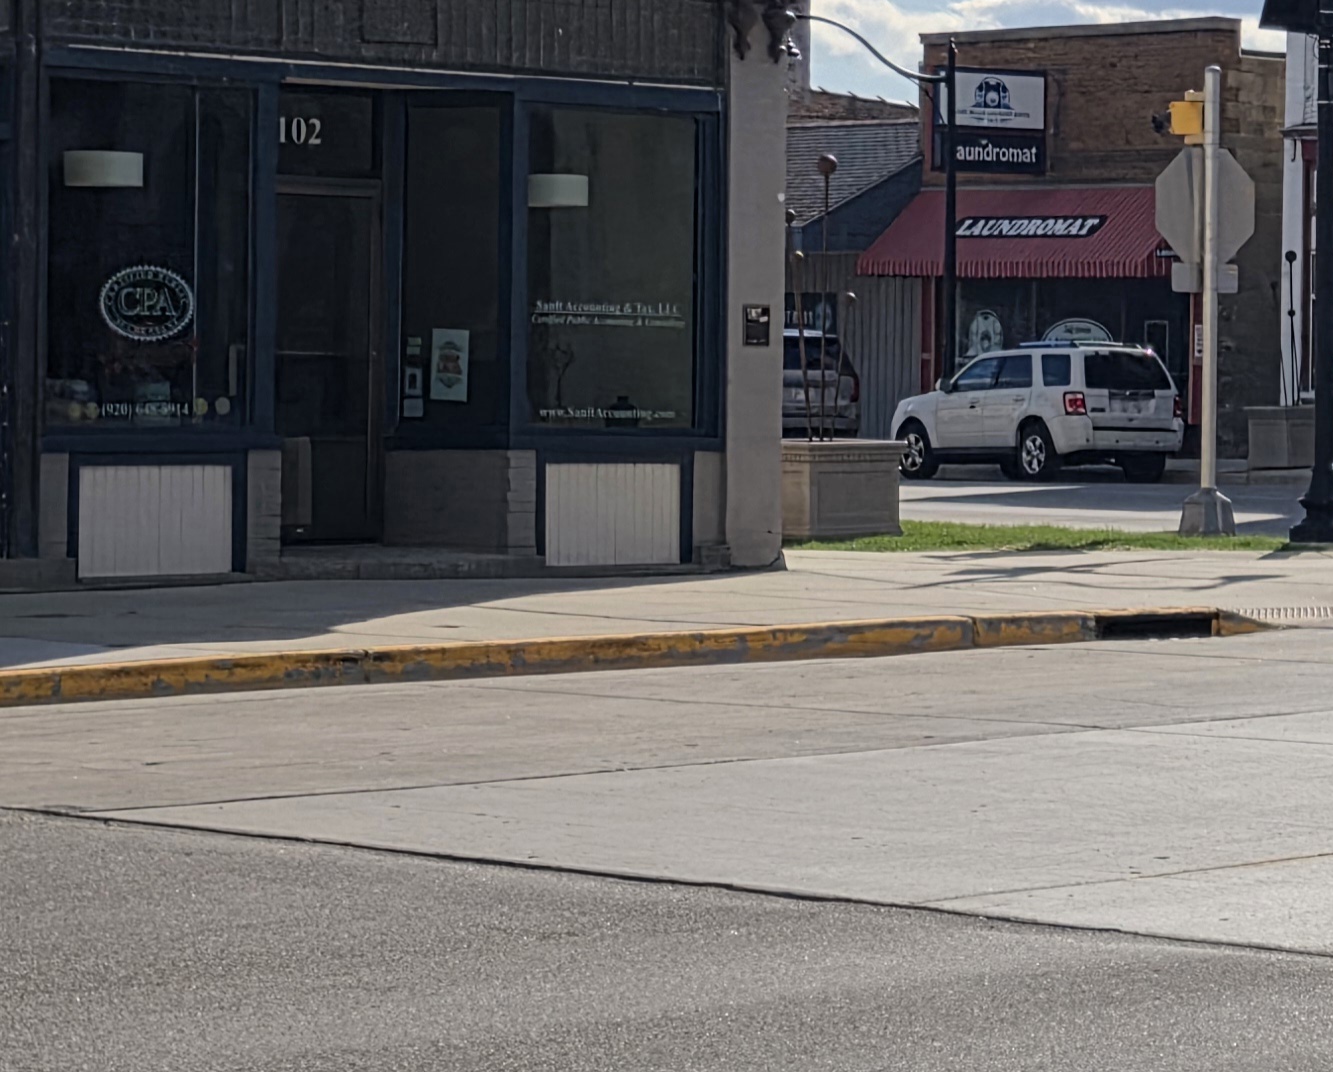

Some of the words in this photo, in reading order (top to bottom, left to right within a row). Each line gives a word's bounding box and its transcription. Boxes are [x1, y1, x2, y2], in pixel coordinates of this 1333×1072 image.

[279, 116, 322, 145] 102
[955, 142, 1037, 164] aundromat
[955, 218, 1100, 237] LAUNDROMAT
[117, 287, 176, 316] CPA
